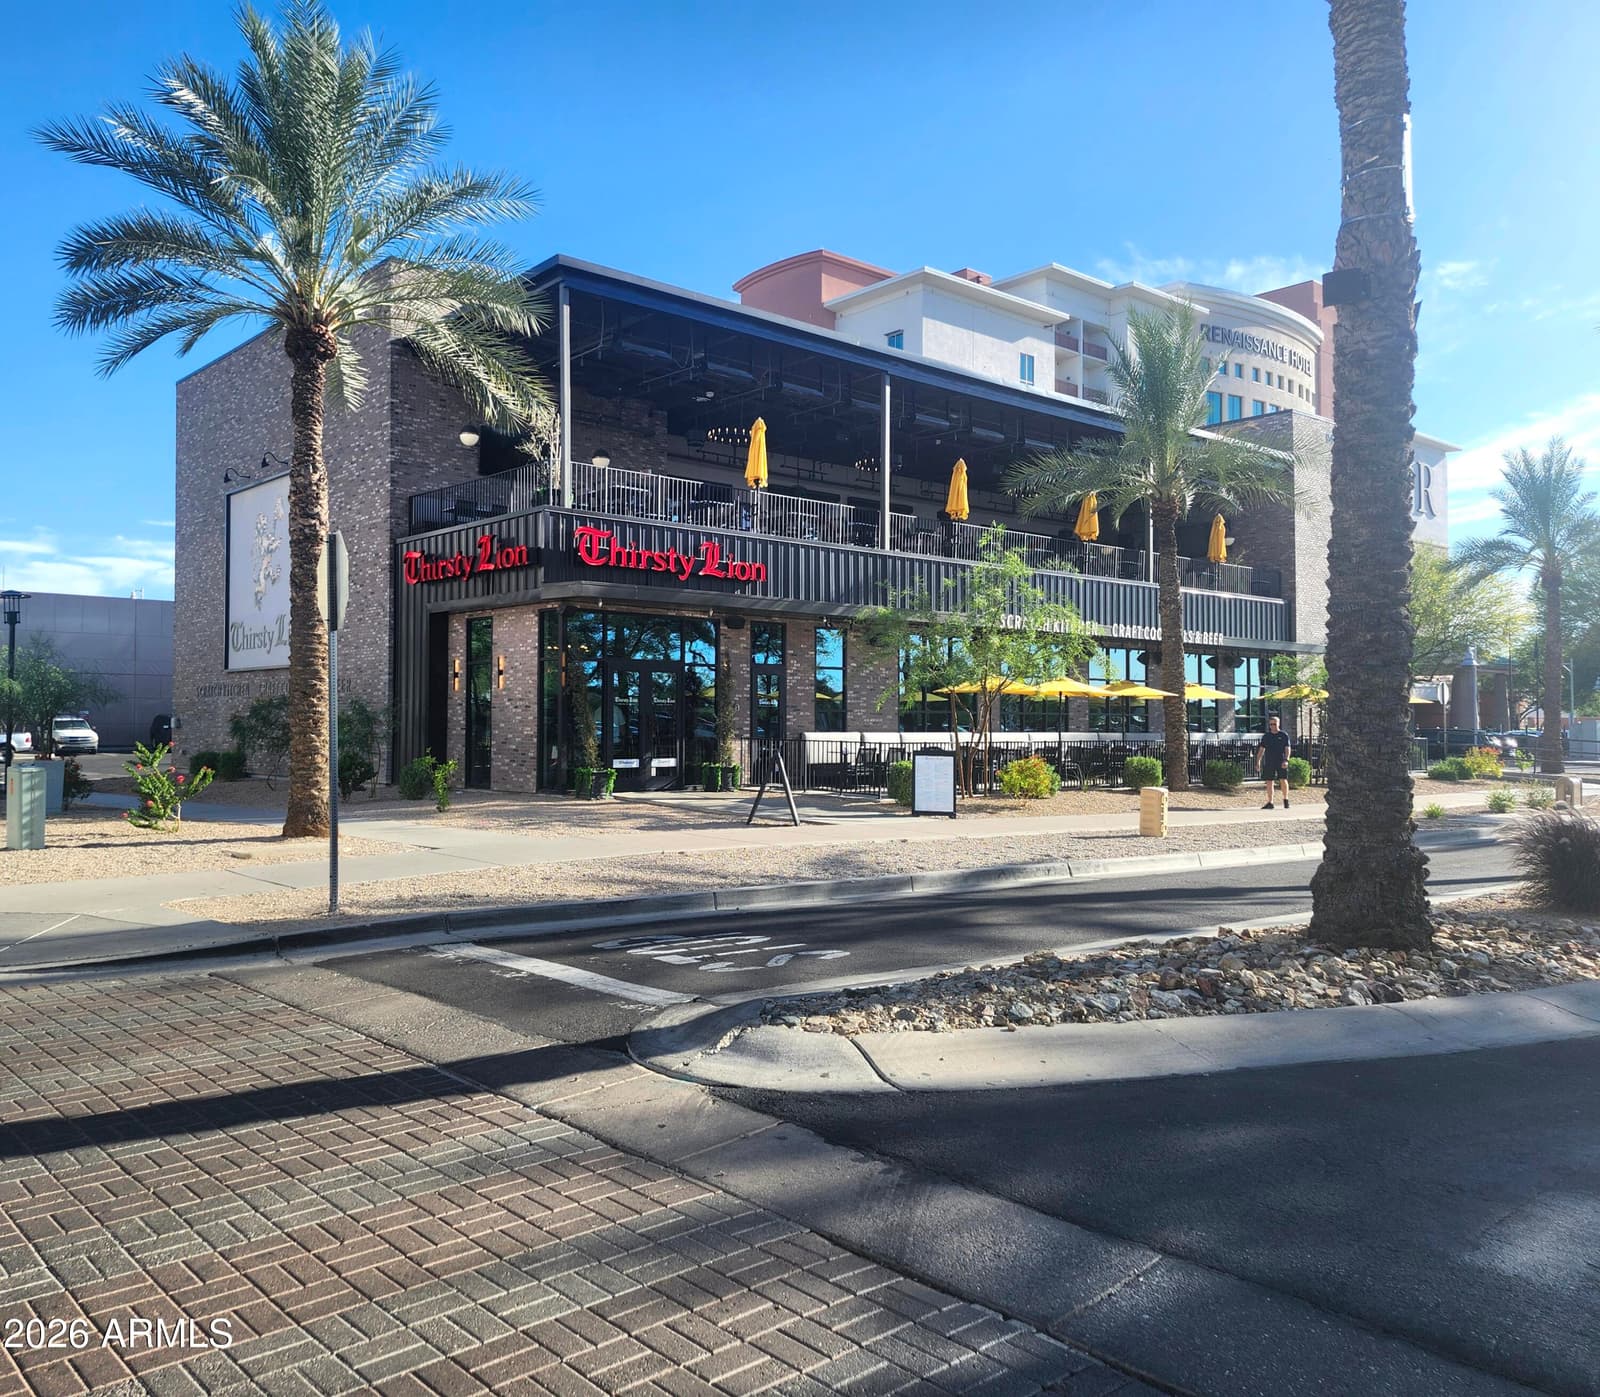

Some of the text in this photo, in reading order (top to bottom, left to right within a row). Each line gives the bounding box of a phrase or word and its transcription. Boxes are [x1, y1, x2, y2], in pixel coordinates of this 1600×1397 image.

[1200, 323, 1288, 364] RENAISSANCE
[1410, 462, 1436, 521] R
[403, 534, 529, 586] Thirsty Lion
[574, 525, 767, 583] Thirsty Lion
[230, 621, 275, 655] Thirsty
[1112, 623, 1145, 640] CRAFT
[1144, 626, 1193, 644] COCLS
[1195, 630, 1203, 645] &
[1203, 631, 1224, 647] BEER
